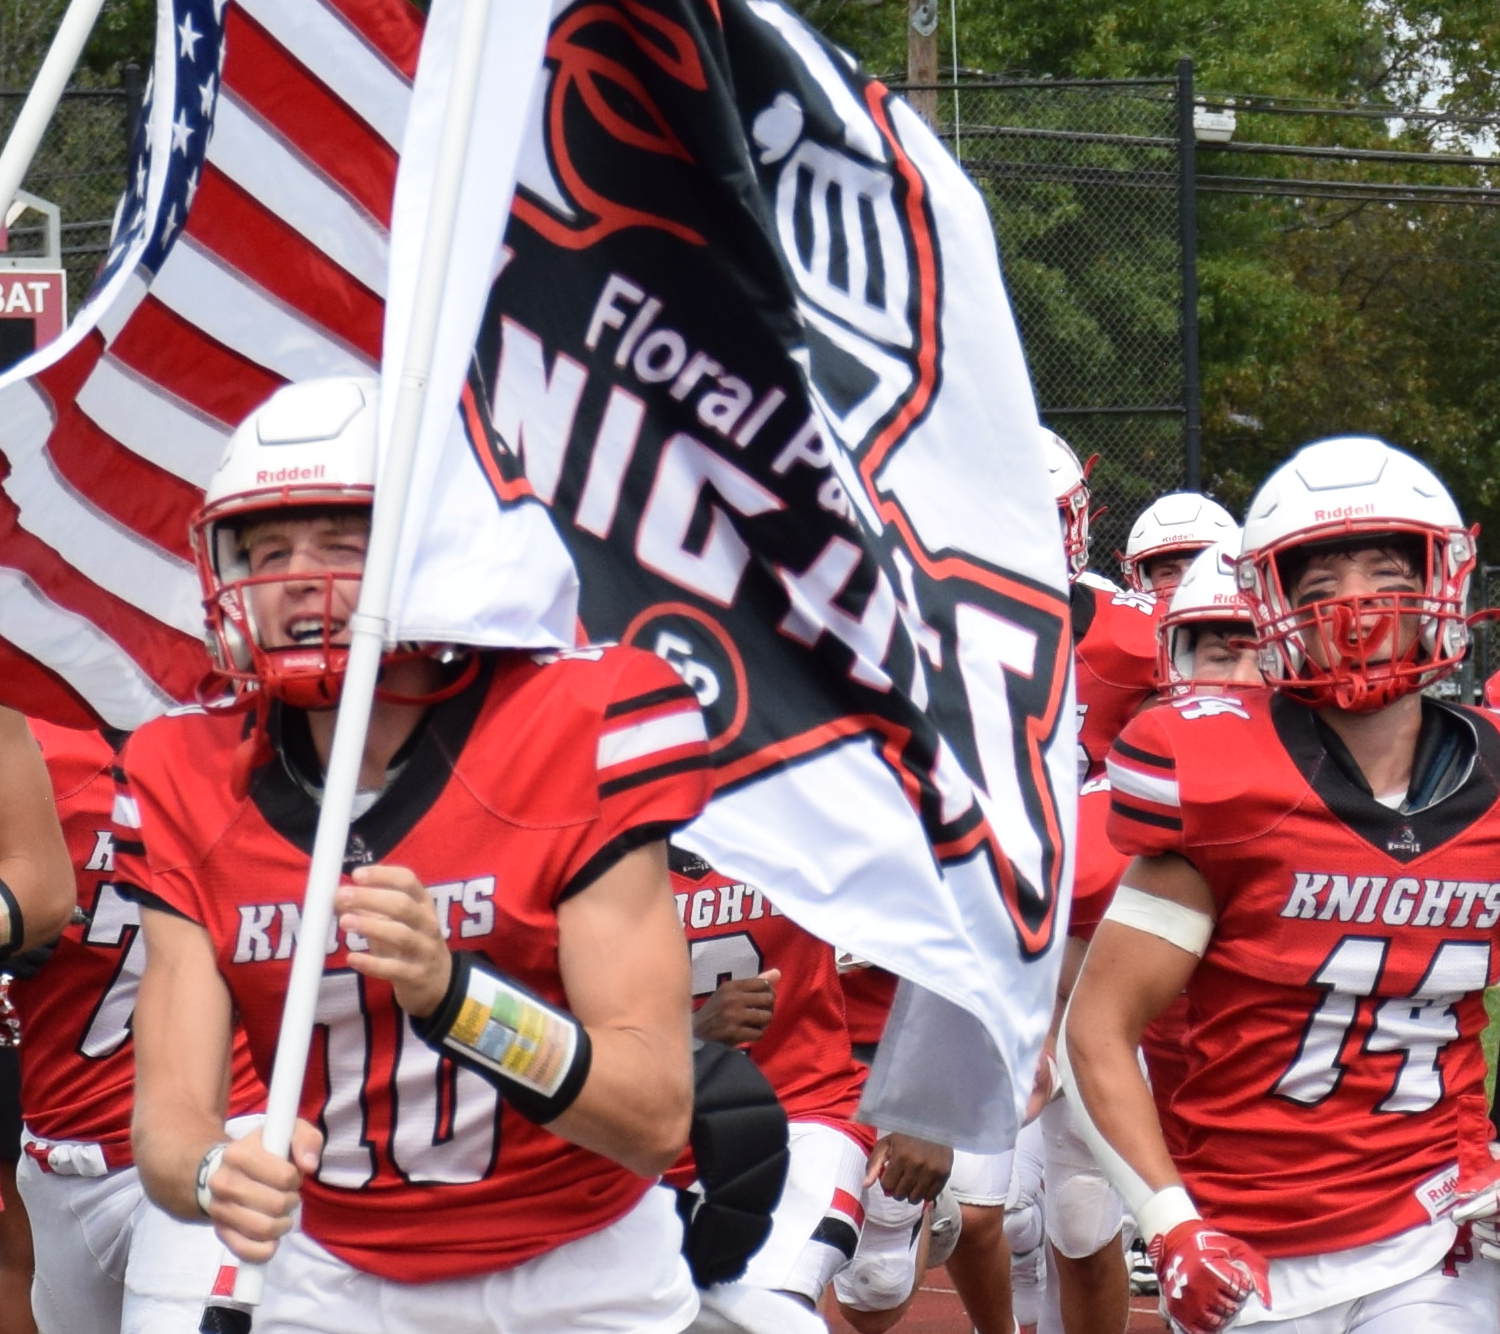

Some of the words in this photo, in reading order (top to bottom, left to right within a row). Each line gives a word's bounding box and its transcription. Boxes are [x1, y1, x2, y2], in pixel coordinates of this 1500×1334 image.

[584, 272, 786, 449] Floral
[772, 413, 857, 526] Pa
[256, 465, 325, 484] Riddell
[1314, 504, 1375, 522] Riddell
[674, 884, 782, 929] IGHT
[1266, 934, 1492, 1114] 14
[312, 971, 499, 1188] 10
[1427, 1171, 1461, 1203] Ridd
